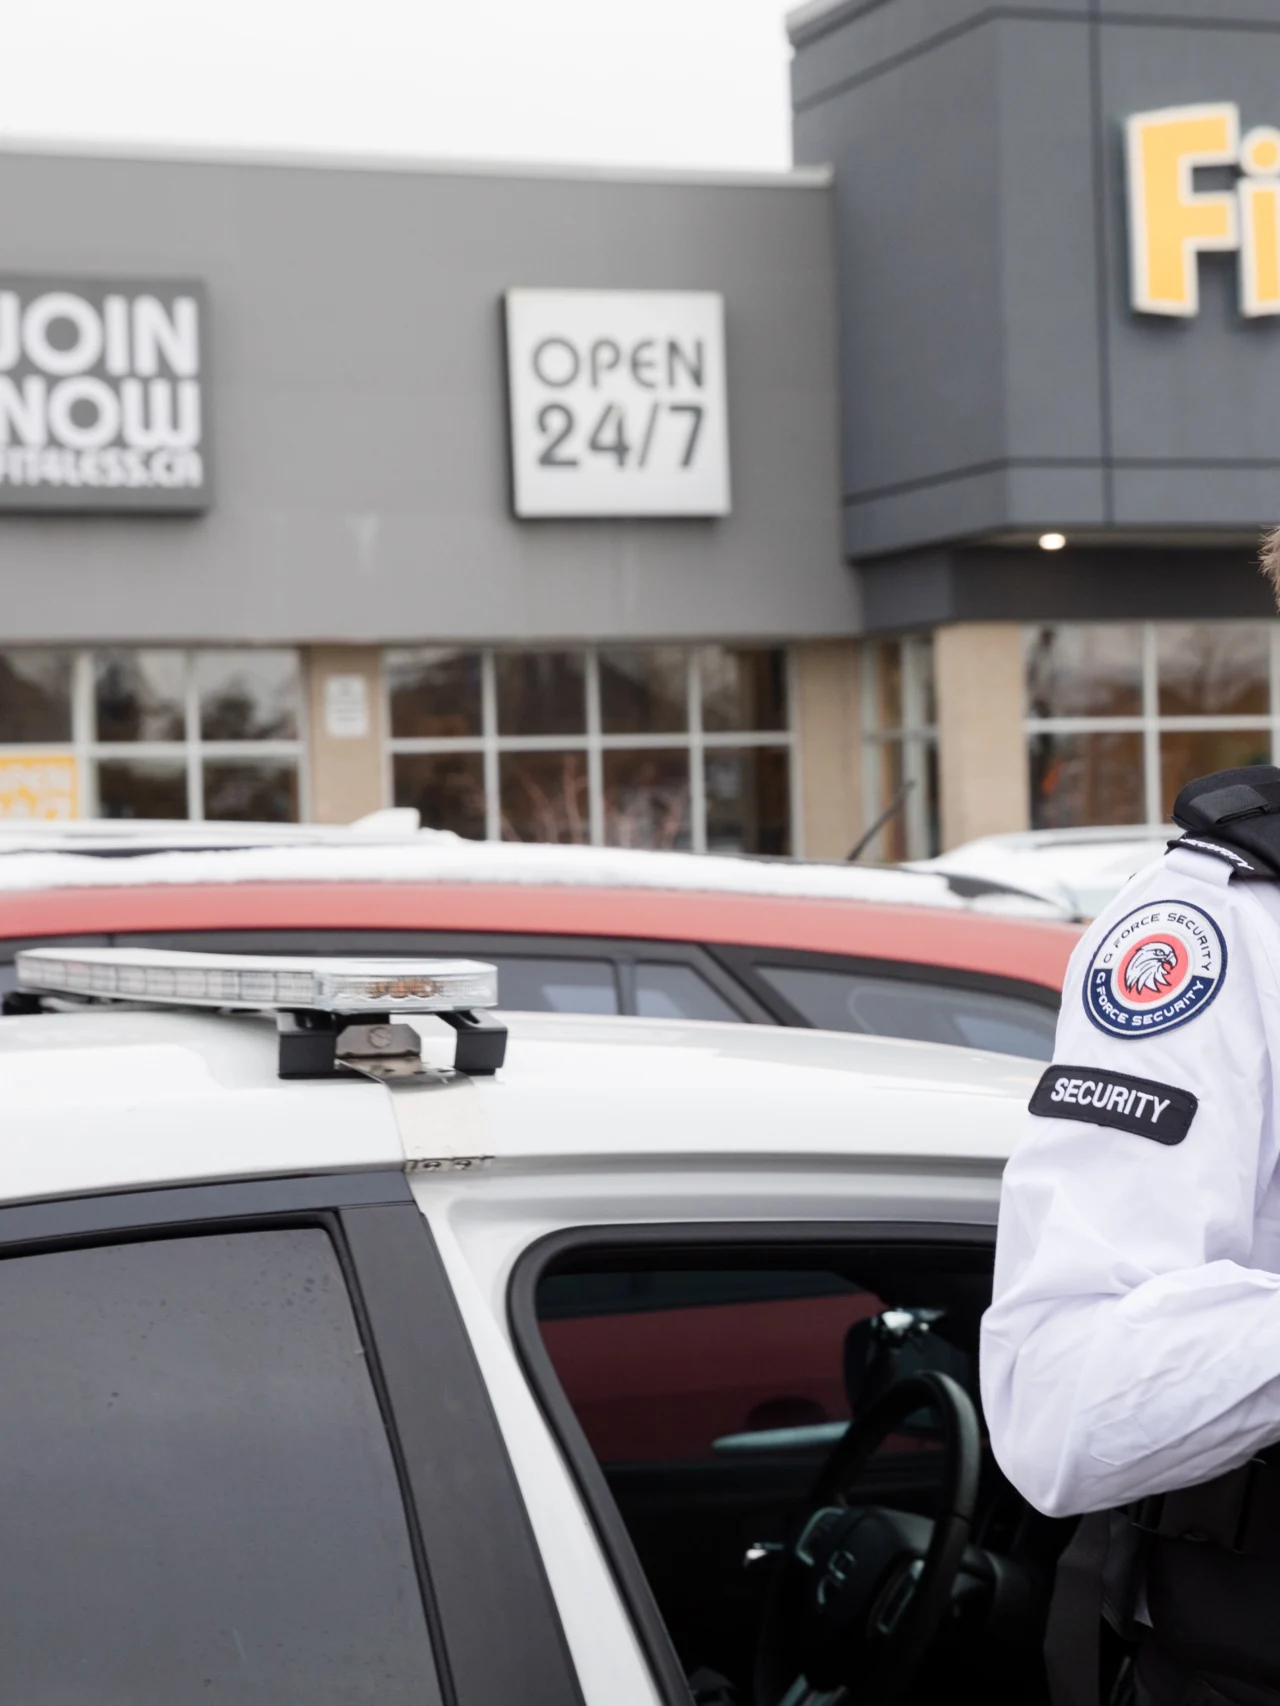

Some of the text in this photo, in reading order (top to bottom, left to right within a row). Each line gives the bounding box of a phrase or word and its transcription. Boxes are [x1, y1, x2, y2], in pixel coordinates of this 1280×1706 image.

[533, 336, 705, 389] OPEN
[0, 373, 202, 450] NOW
[537, 402, 706, 469] 24/7
[1113, 913, 1160, 948] FORCE
[1167, 912, 1212, 971] SECURITY
[1096, 986, 1129, 1024] FORCE
[1131, 980, 1204, 1026] SECURITY
[1050, 1077, 1171, 1124] SECURITY
